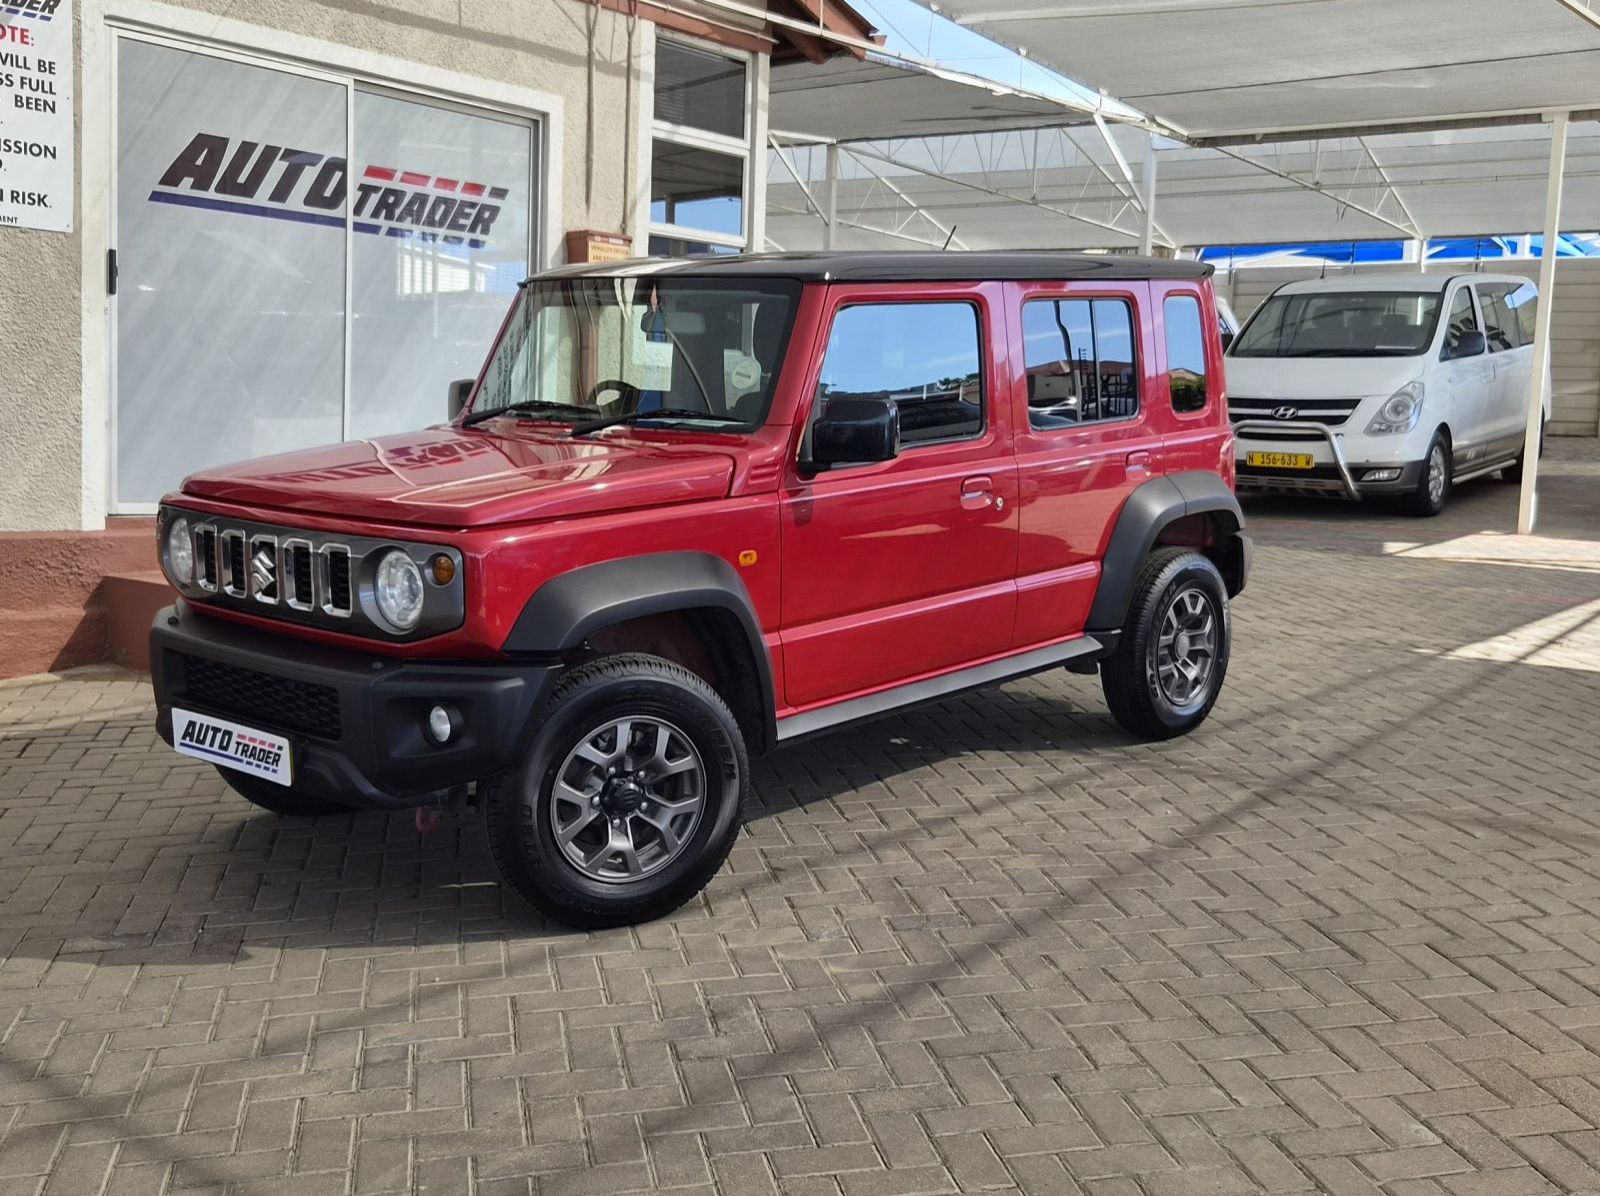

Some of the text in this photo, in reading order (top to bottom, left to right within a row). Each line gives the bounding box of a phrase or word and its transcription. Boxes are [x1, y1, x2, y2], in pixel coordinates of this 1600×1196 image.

[37, 58, 56, 75] BE
[20, 76, 57, 95] FULL
[14, 93, 56, 114] BEEN
[158, 132, 501, 235] AUTO TRADER
[10, 189, 52, 208] RISK.
[0, 215, 18, 224] ENT
[1248, 453, 1254, 465] N
[1305, 456, 1311, 467] W
[181, 719, 281, 768] AUTO TRADER
